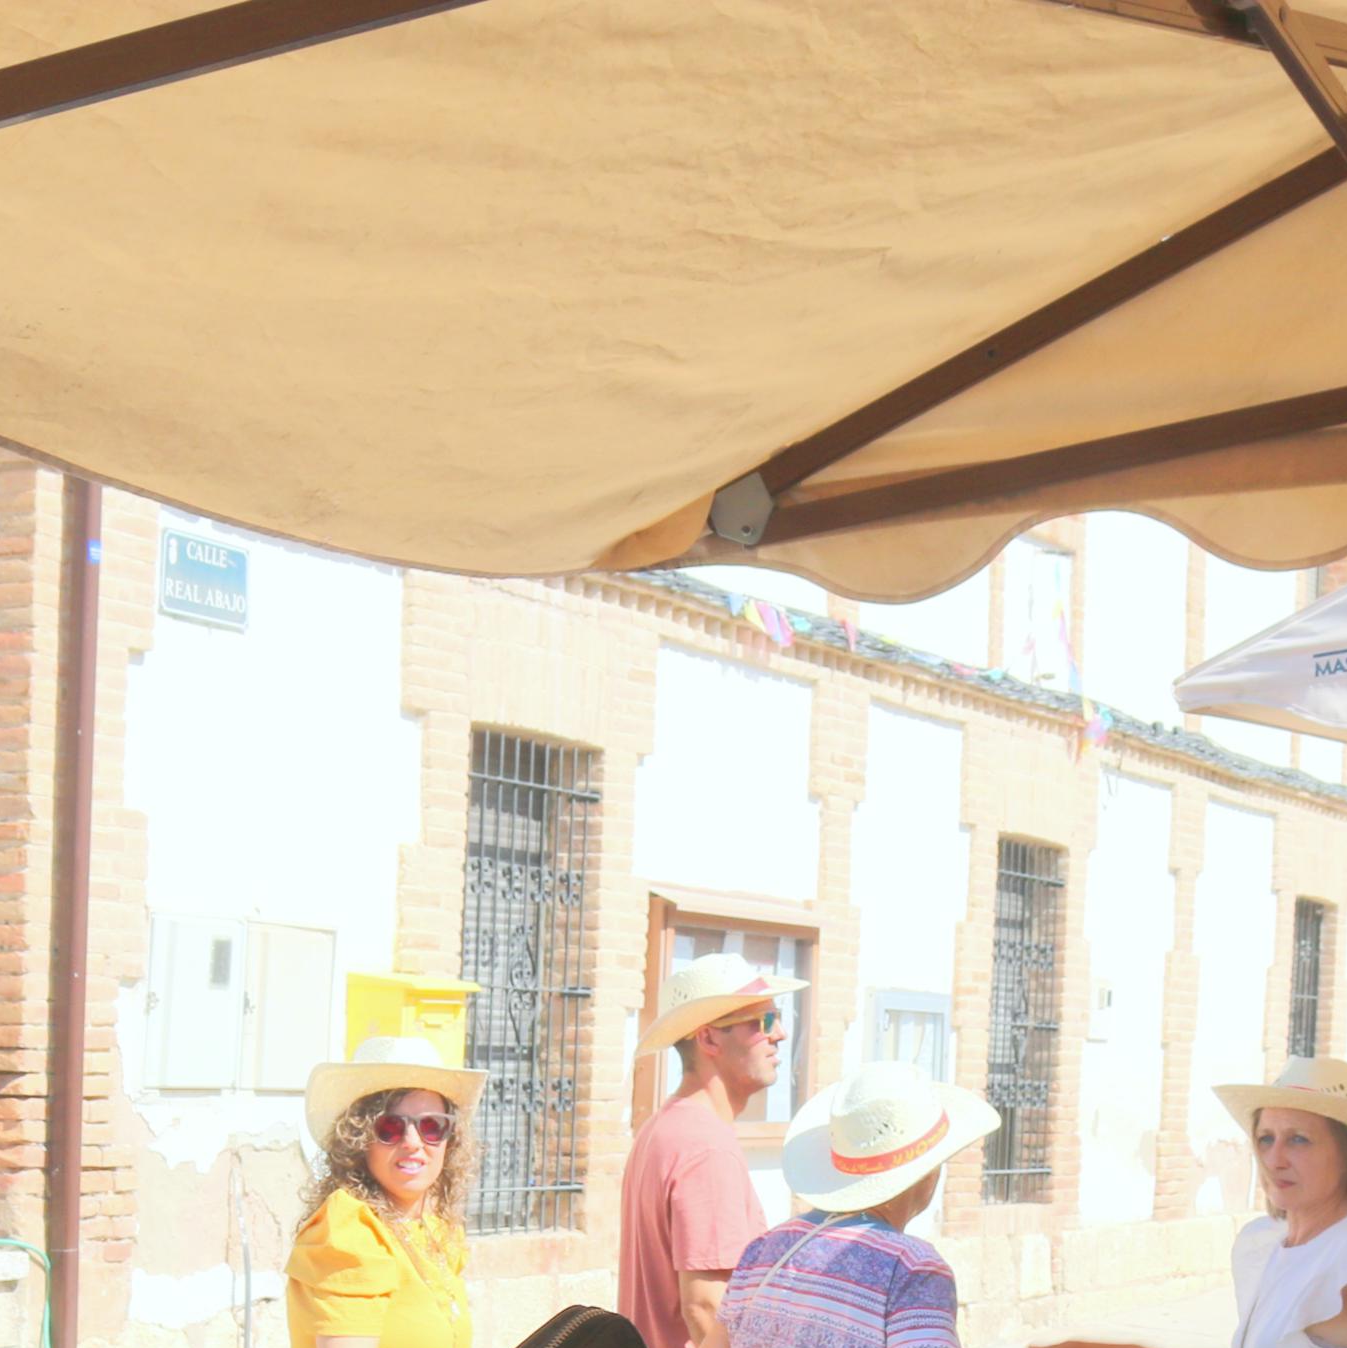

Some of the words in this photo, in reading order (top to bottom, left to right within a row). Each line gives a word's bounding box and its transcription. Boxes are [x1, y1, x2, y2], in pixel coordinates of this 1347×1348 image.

[186, 541, 228, 569] CALLE
[165, 578, 201, 604] REAL
[204, 586, 246, 614] ABAJO
